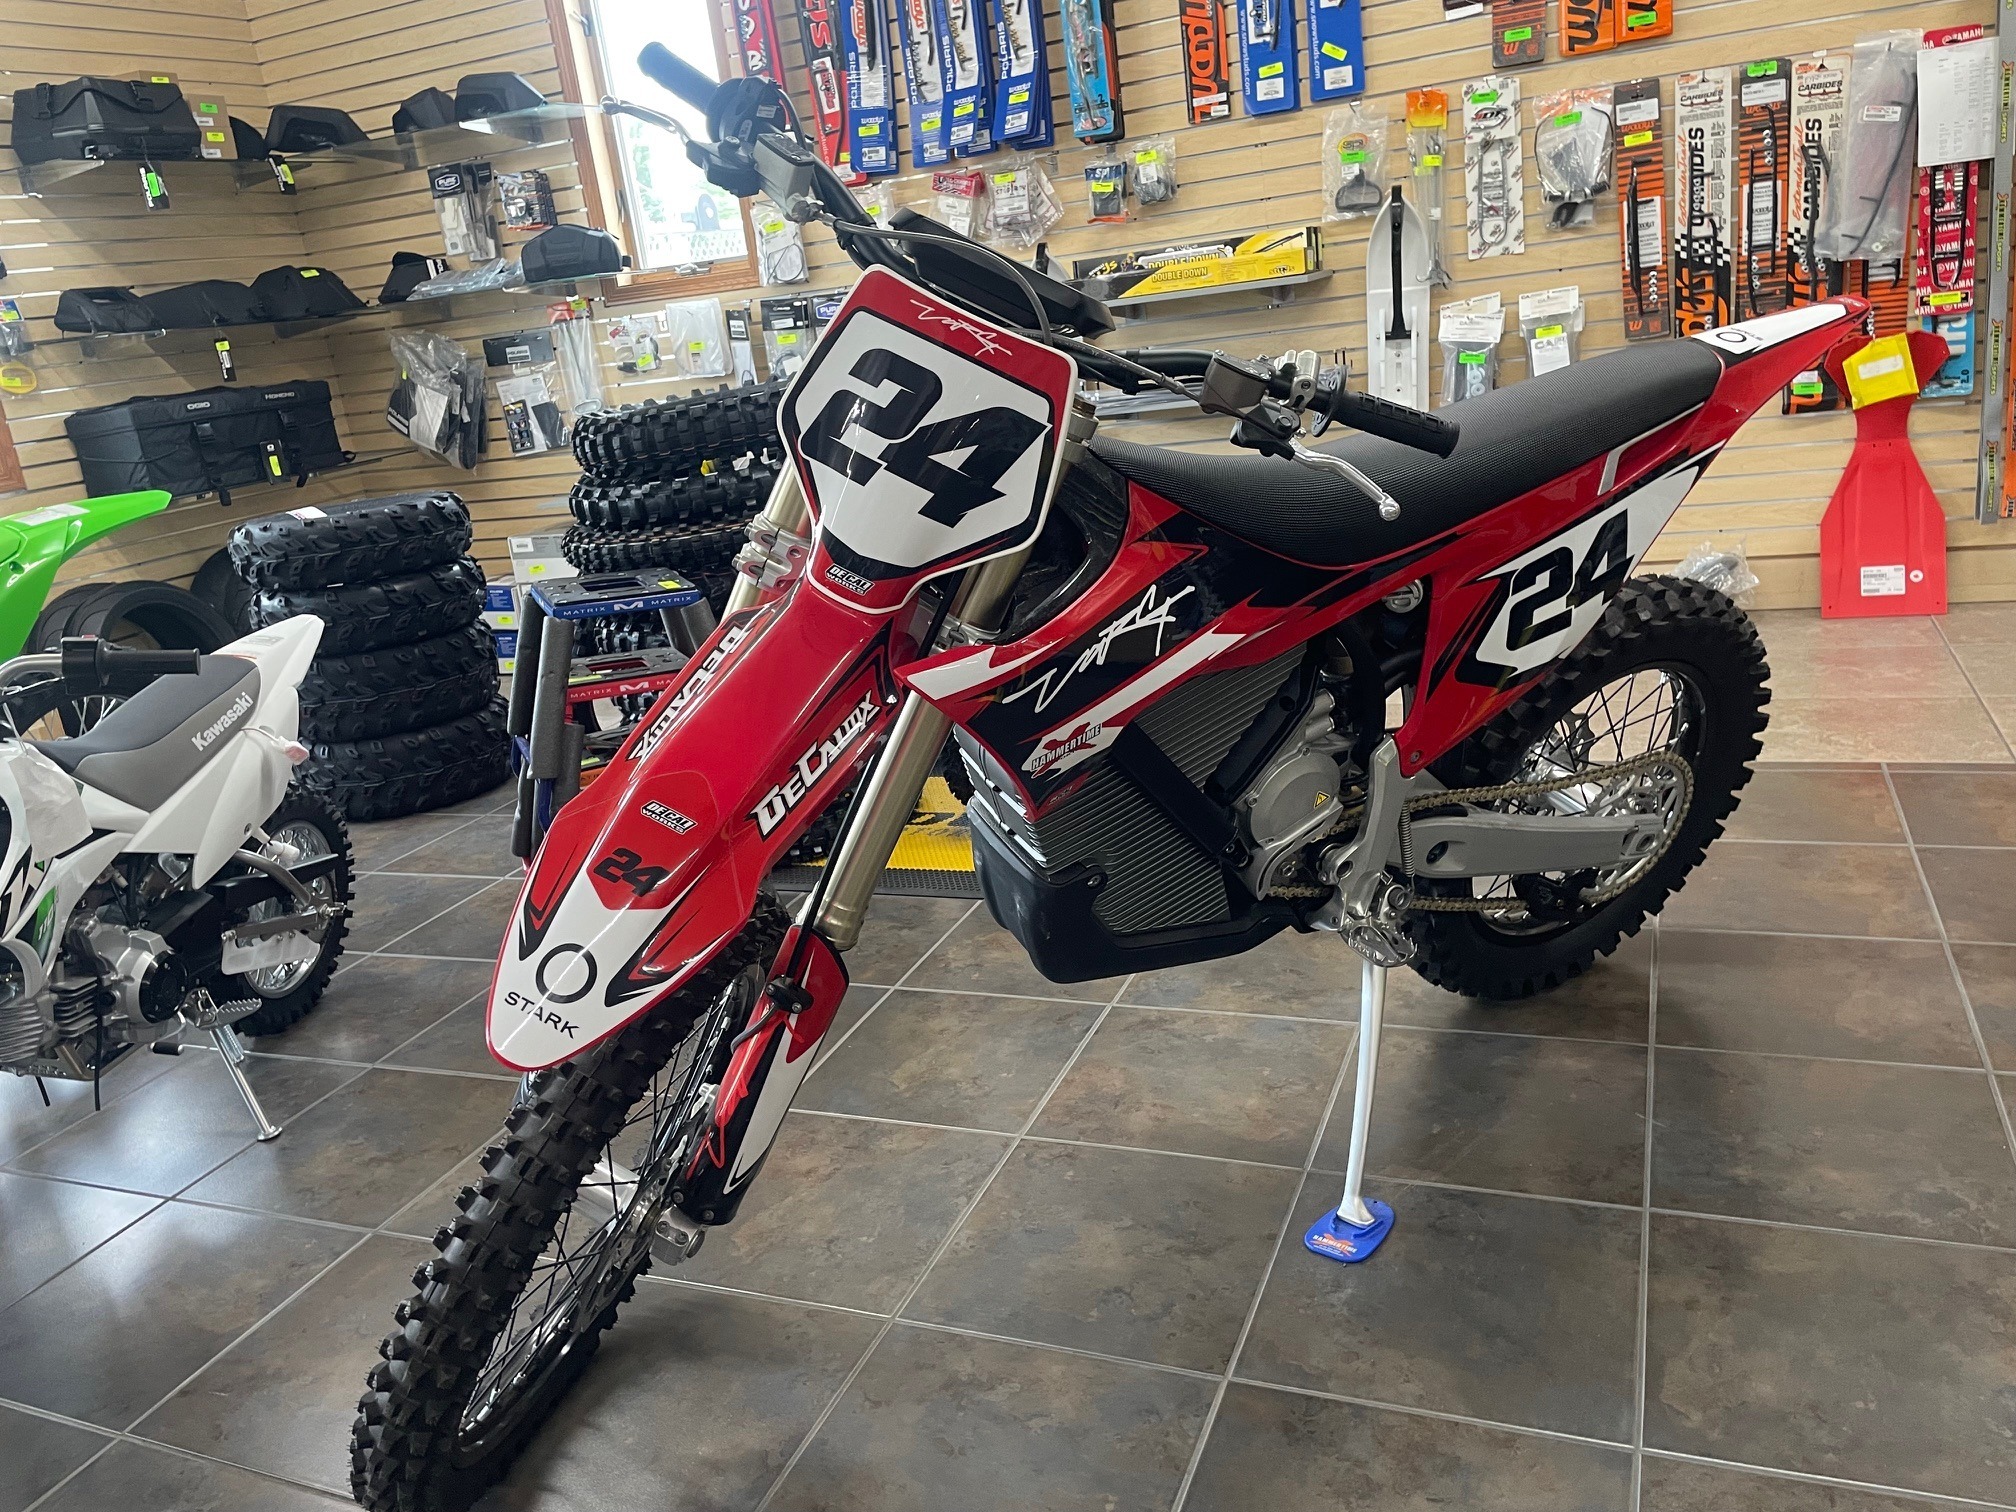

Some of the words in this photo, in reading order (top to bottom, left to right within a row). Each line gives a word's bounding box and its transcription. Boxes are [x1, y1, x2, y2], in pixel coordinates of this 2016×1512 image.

[941, 35, 953, 93] POLARIS
[996, 21, 1008, 80] POLARIS
[1240, 9, 1251, 95] www.snowstuds.com
[1309, 0, 1321, 79] ww.snowstuds.com
[848, 52, 859, 109] POLARIS
[1797, 80, 1843, 92] CARBIDES
[1152, 271, 1182, 283] DOUBLE
[1183, 266, 1207, 278] DOWN
[800, 347, 1049, 529] 24
[830, 565, 873, 591] DECAL
[1506, 508, 1635, 651] 24
[563, 606, 605, 616] MATRIX
[651, 595, 692, 605] MATRIX
[570, 687, 612, 698] MATRIX
[191, 691, 254, 752] Kawasaki
[1031, 723, 1101, 771] HAMMERTIME
[648, 800, 697, 830] DECAL
[593, 847, 673, 898] 24
[504, 991, 580, 1039] STARK
